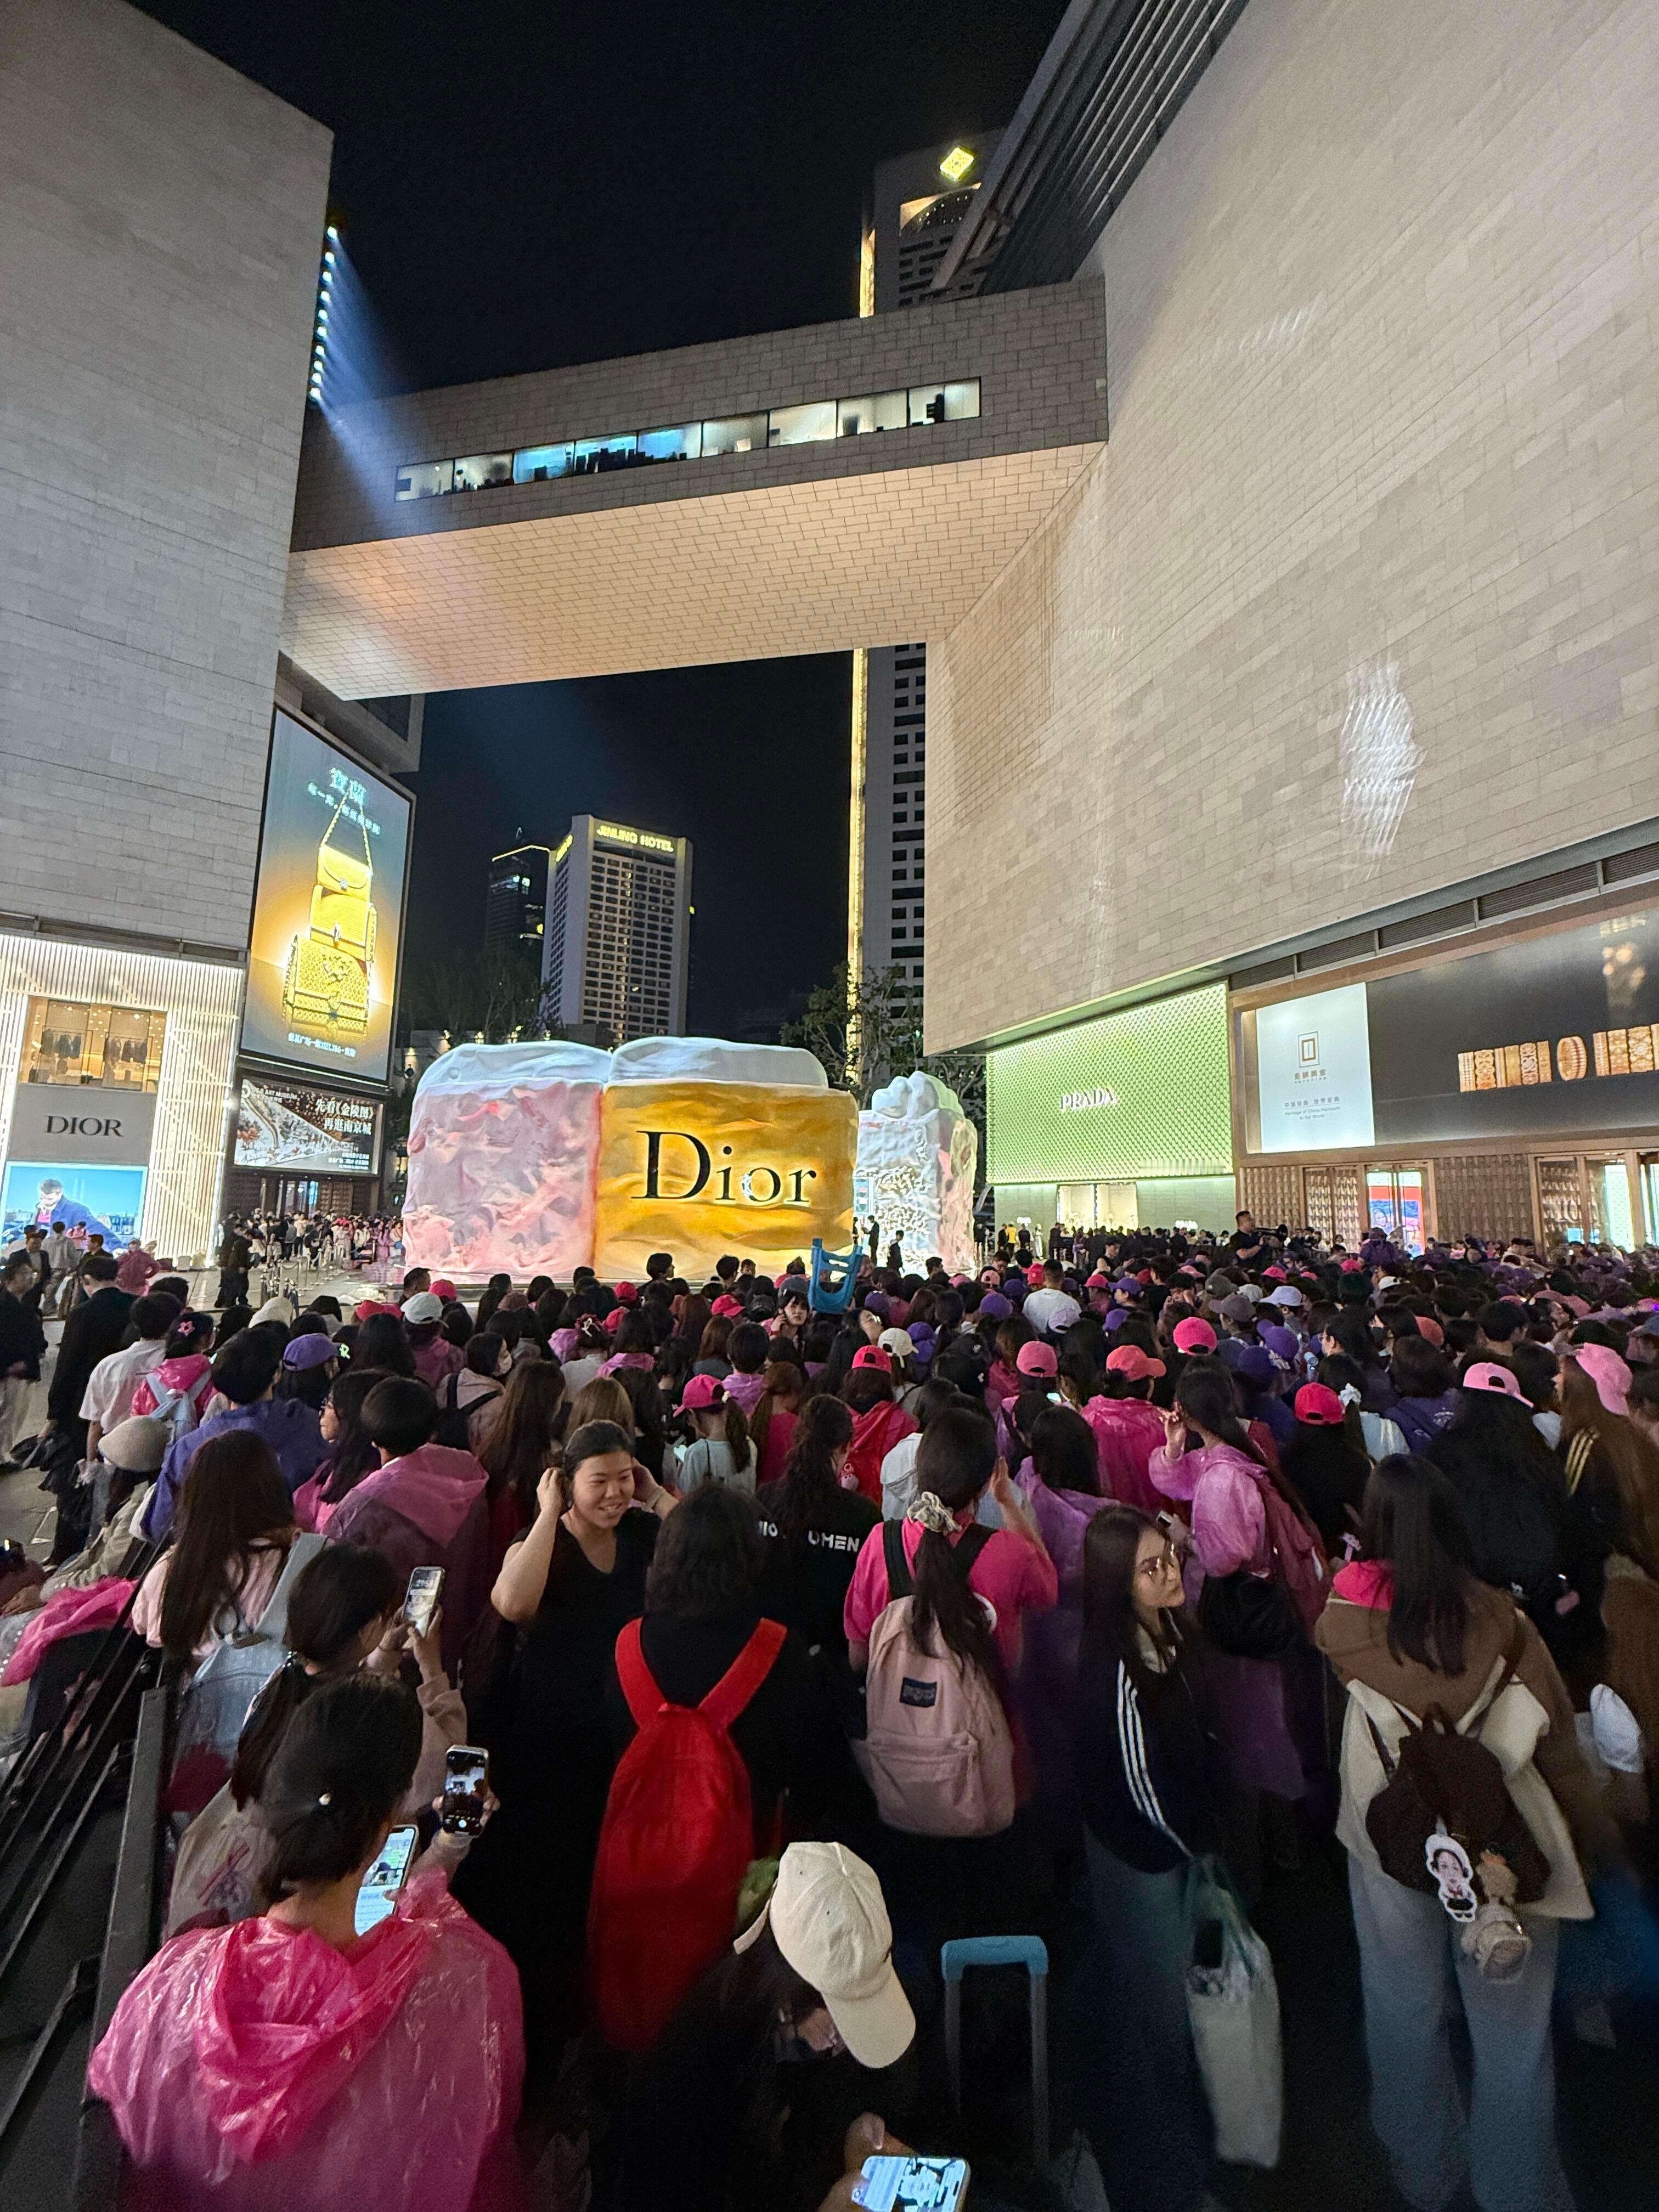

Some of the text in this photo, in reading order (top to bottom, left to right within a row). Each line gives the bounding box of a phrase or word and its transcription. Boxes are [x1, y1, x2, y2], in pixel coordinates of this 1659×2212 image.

[597, 825, 674, 852] JINLING HOTEL
[1060, 1088, 1117, 1111] PRADA
[45, 1115, 124, 1137] DIOR
[323, 1117, 372, 1135] 再逛南京城
[631, 1130, 817, 1202] Dior
